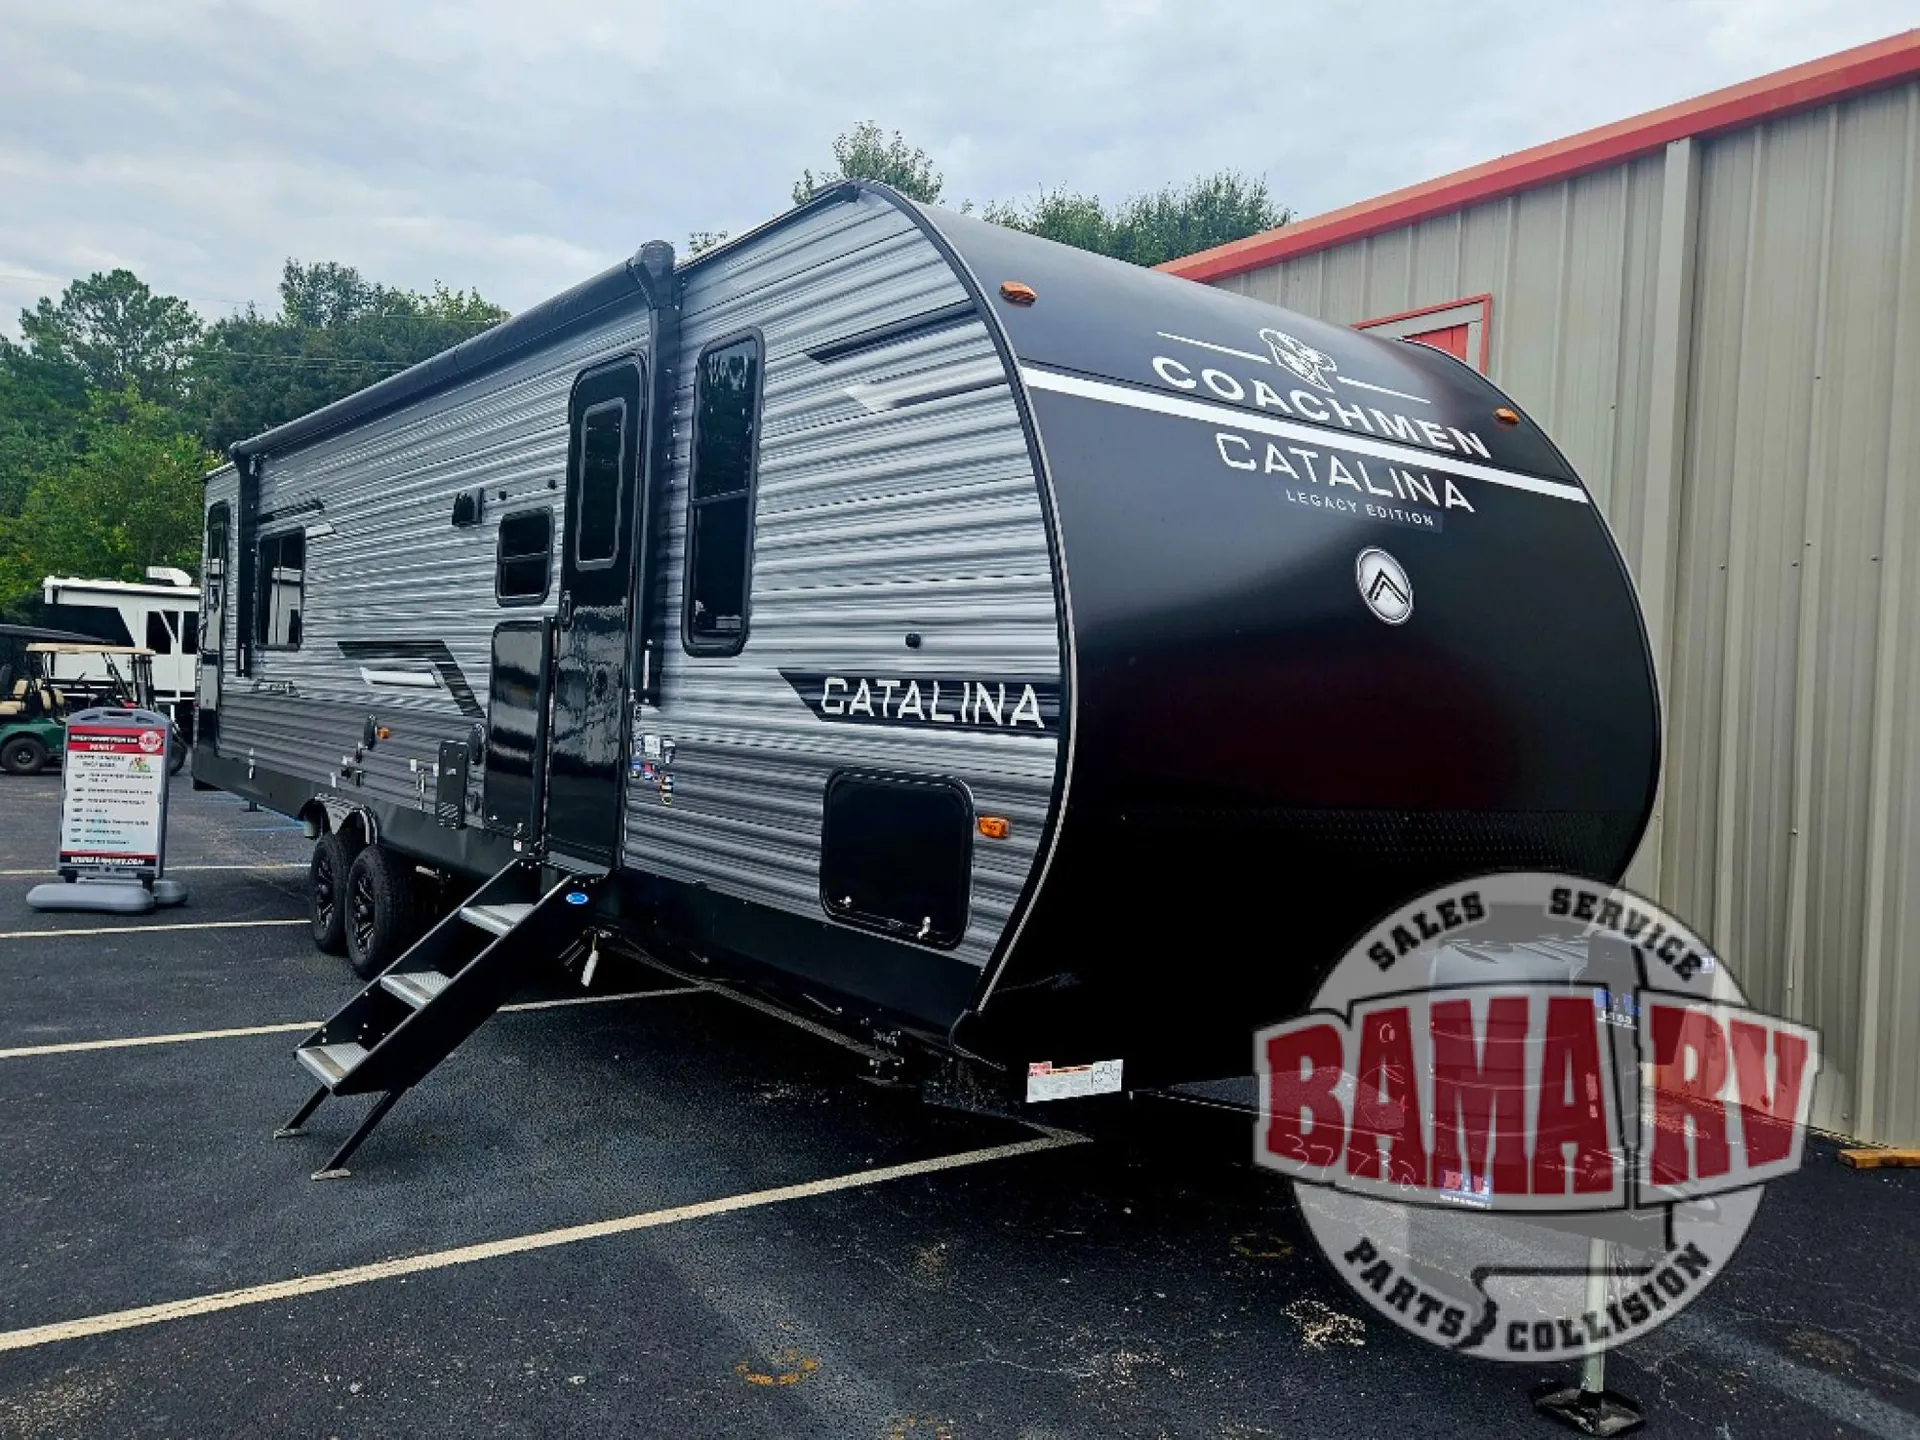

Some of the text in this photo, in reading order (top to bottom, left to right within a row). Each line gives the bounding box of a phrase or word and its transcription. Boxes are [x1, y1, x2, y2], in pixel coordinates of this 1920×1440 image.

[1152, 356, 1492, 459] COACHMEN
[1216, 432, 1476, 513] CATALINA
[1285, 488, 1434, 527] LEGACY EDITION
[821, 676, 1046, 729] CATALINA
